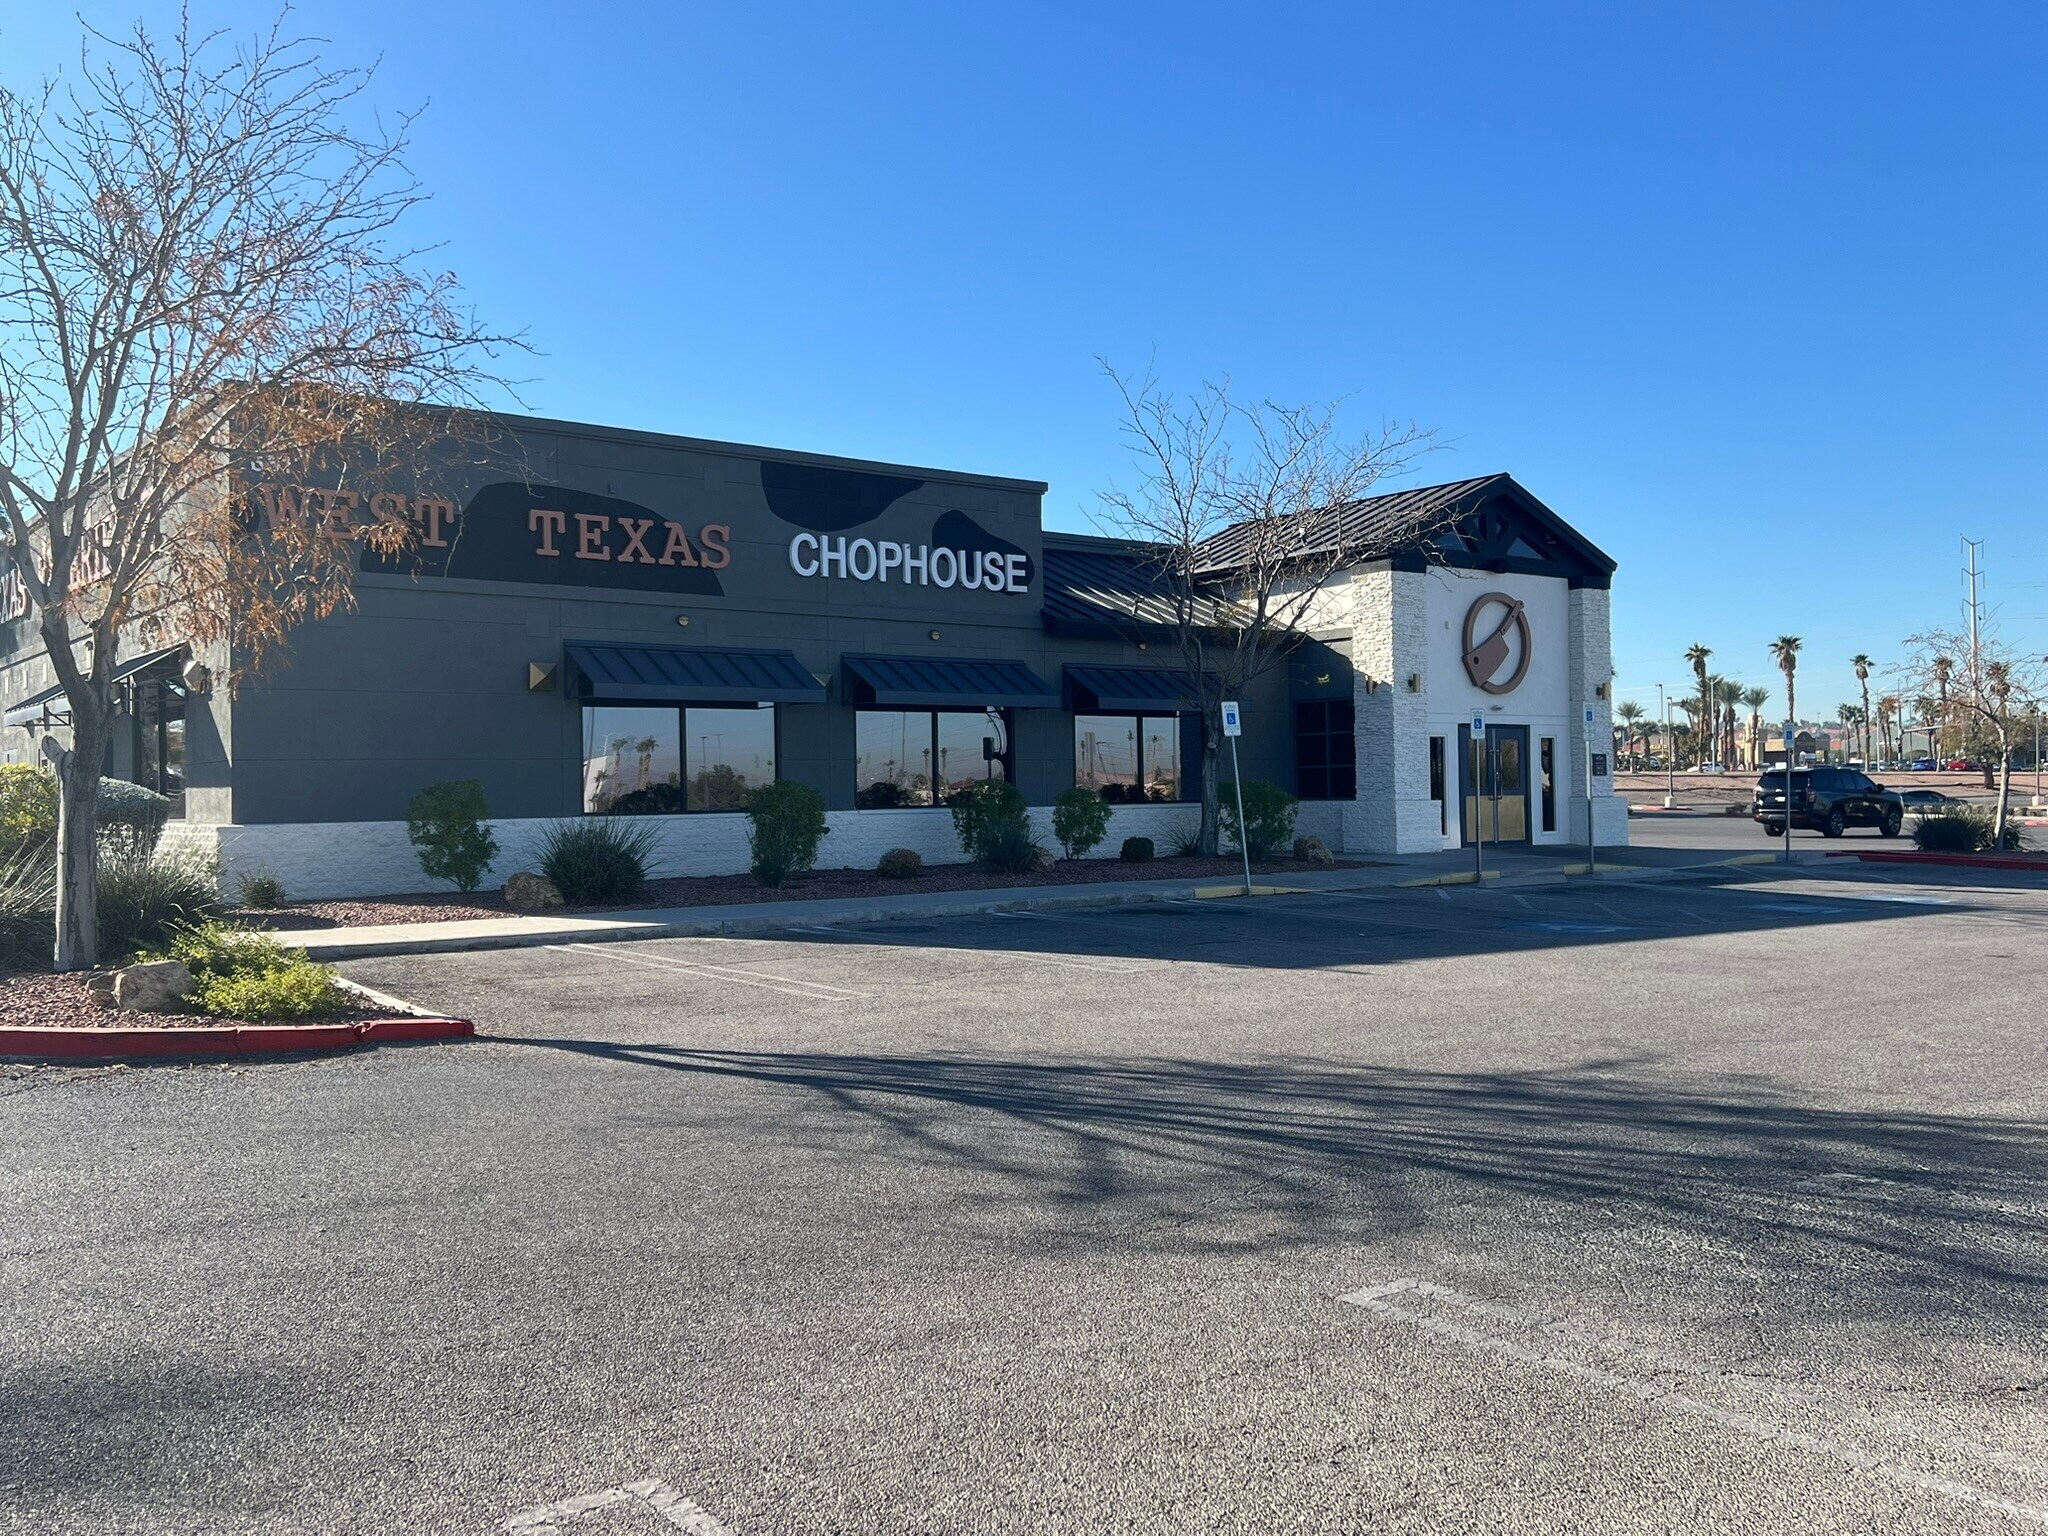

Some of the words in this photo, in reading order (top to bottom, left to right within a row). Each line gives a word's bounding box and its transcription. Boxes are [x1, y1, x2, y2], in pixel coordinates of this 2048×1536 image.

[259, 483, 454, 548] WEST
[528, 509, 731, 569] TEXAS
[789, 533, 1028, 593] CHOPHOUSE
[0, 568, 28, 625] XAS
